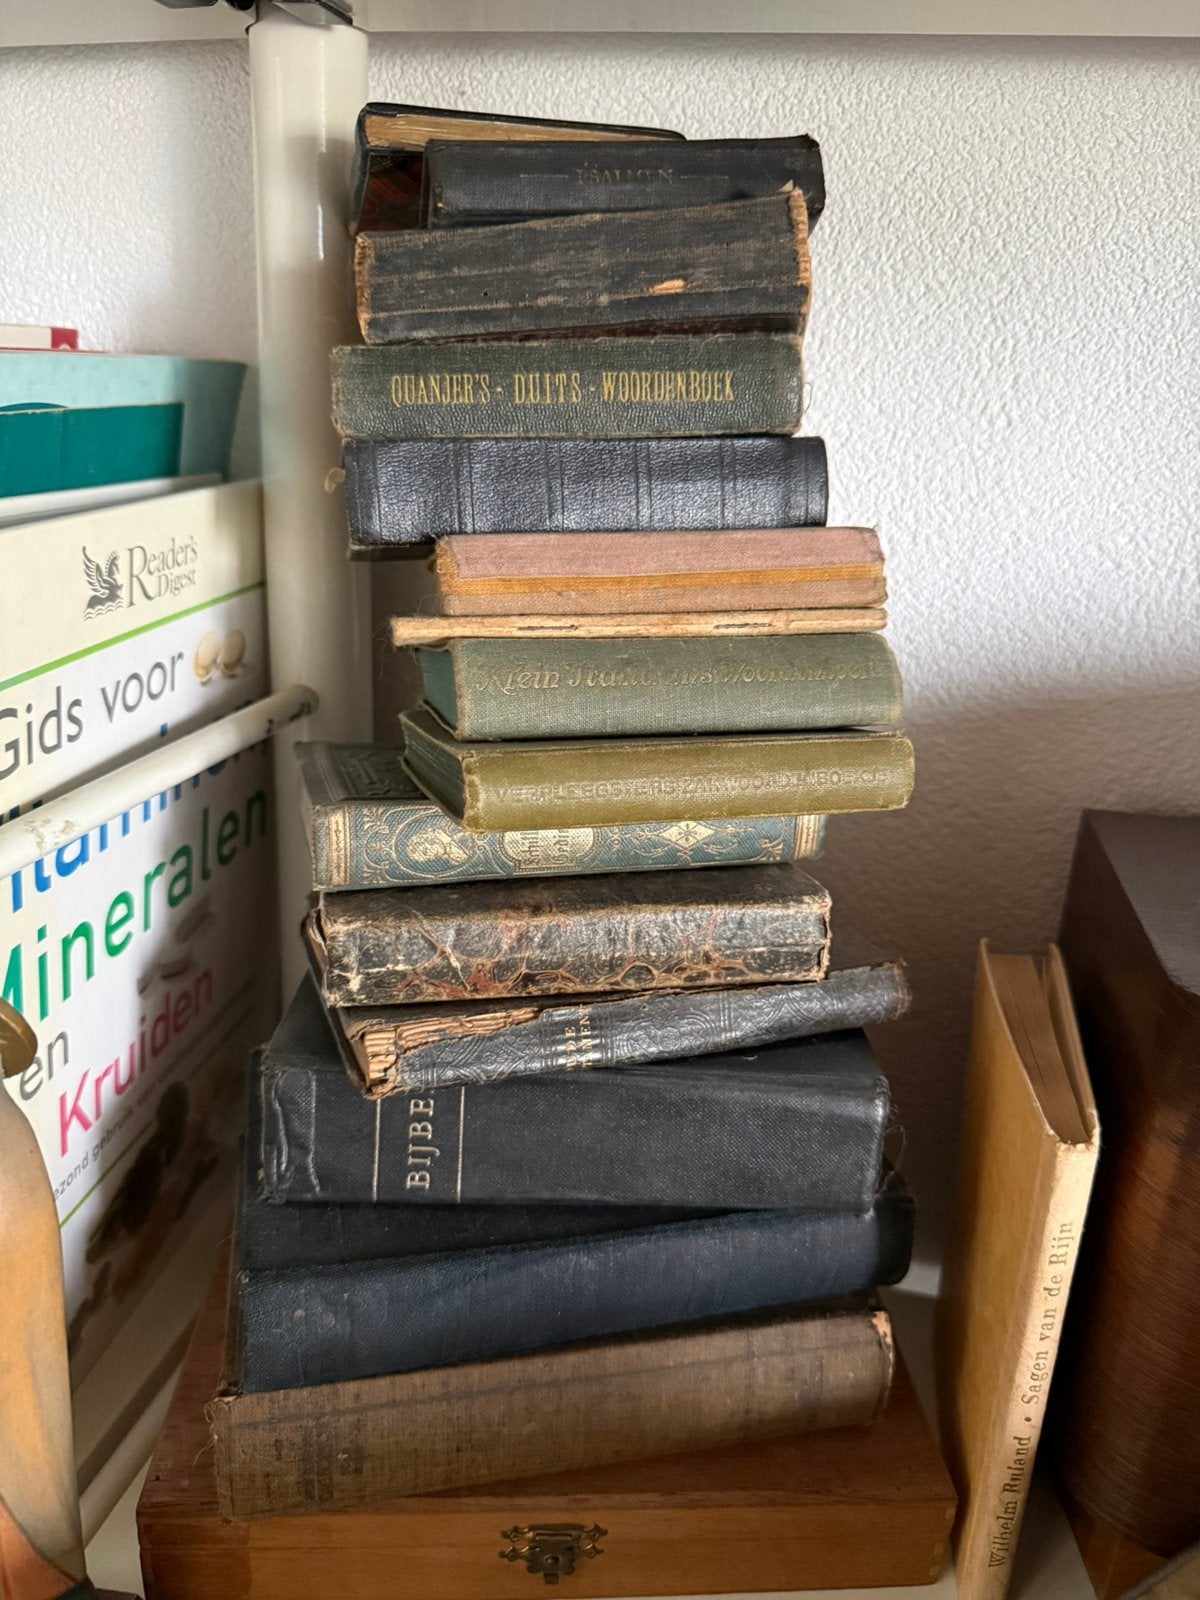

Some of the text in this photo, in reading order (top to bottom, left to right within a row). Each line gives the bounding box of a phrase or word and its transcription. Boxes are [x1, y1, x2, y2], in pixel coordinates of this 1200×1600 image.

[390, 370, 735, 407] QUANJER'S DUITS WOORDENBOEK
[126, 535, 198, 608] Reader's Digest
[0, 651, 185, 781] Gids voor
[520, 831, 545, 867] Schill
[551, 829, 569, 865] Gedi
[19, 1031, 70, 1102] en
[58, 965, 215, 1157] Kruiden
[563, 1026, 577, 1072] UDE
[578, 1003, 592, 1069] TAMENT
[54, 1151, 89, 1201] ezond
[406, 1097, 440, 1190] BIJBE
[988, 1220, 1074, 1568] Wilhelm Ruland Sagen van de Rijn
